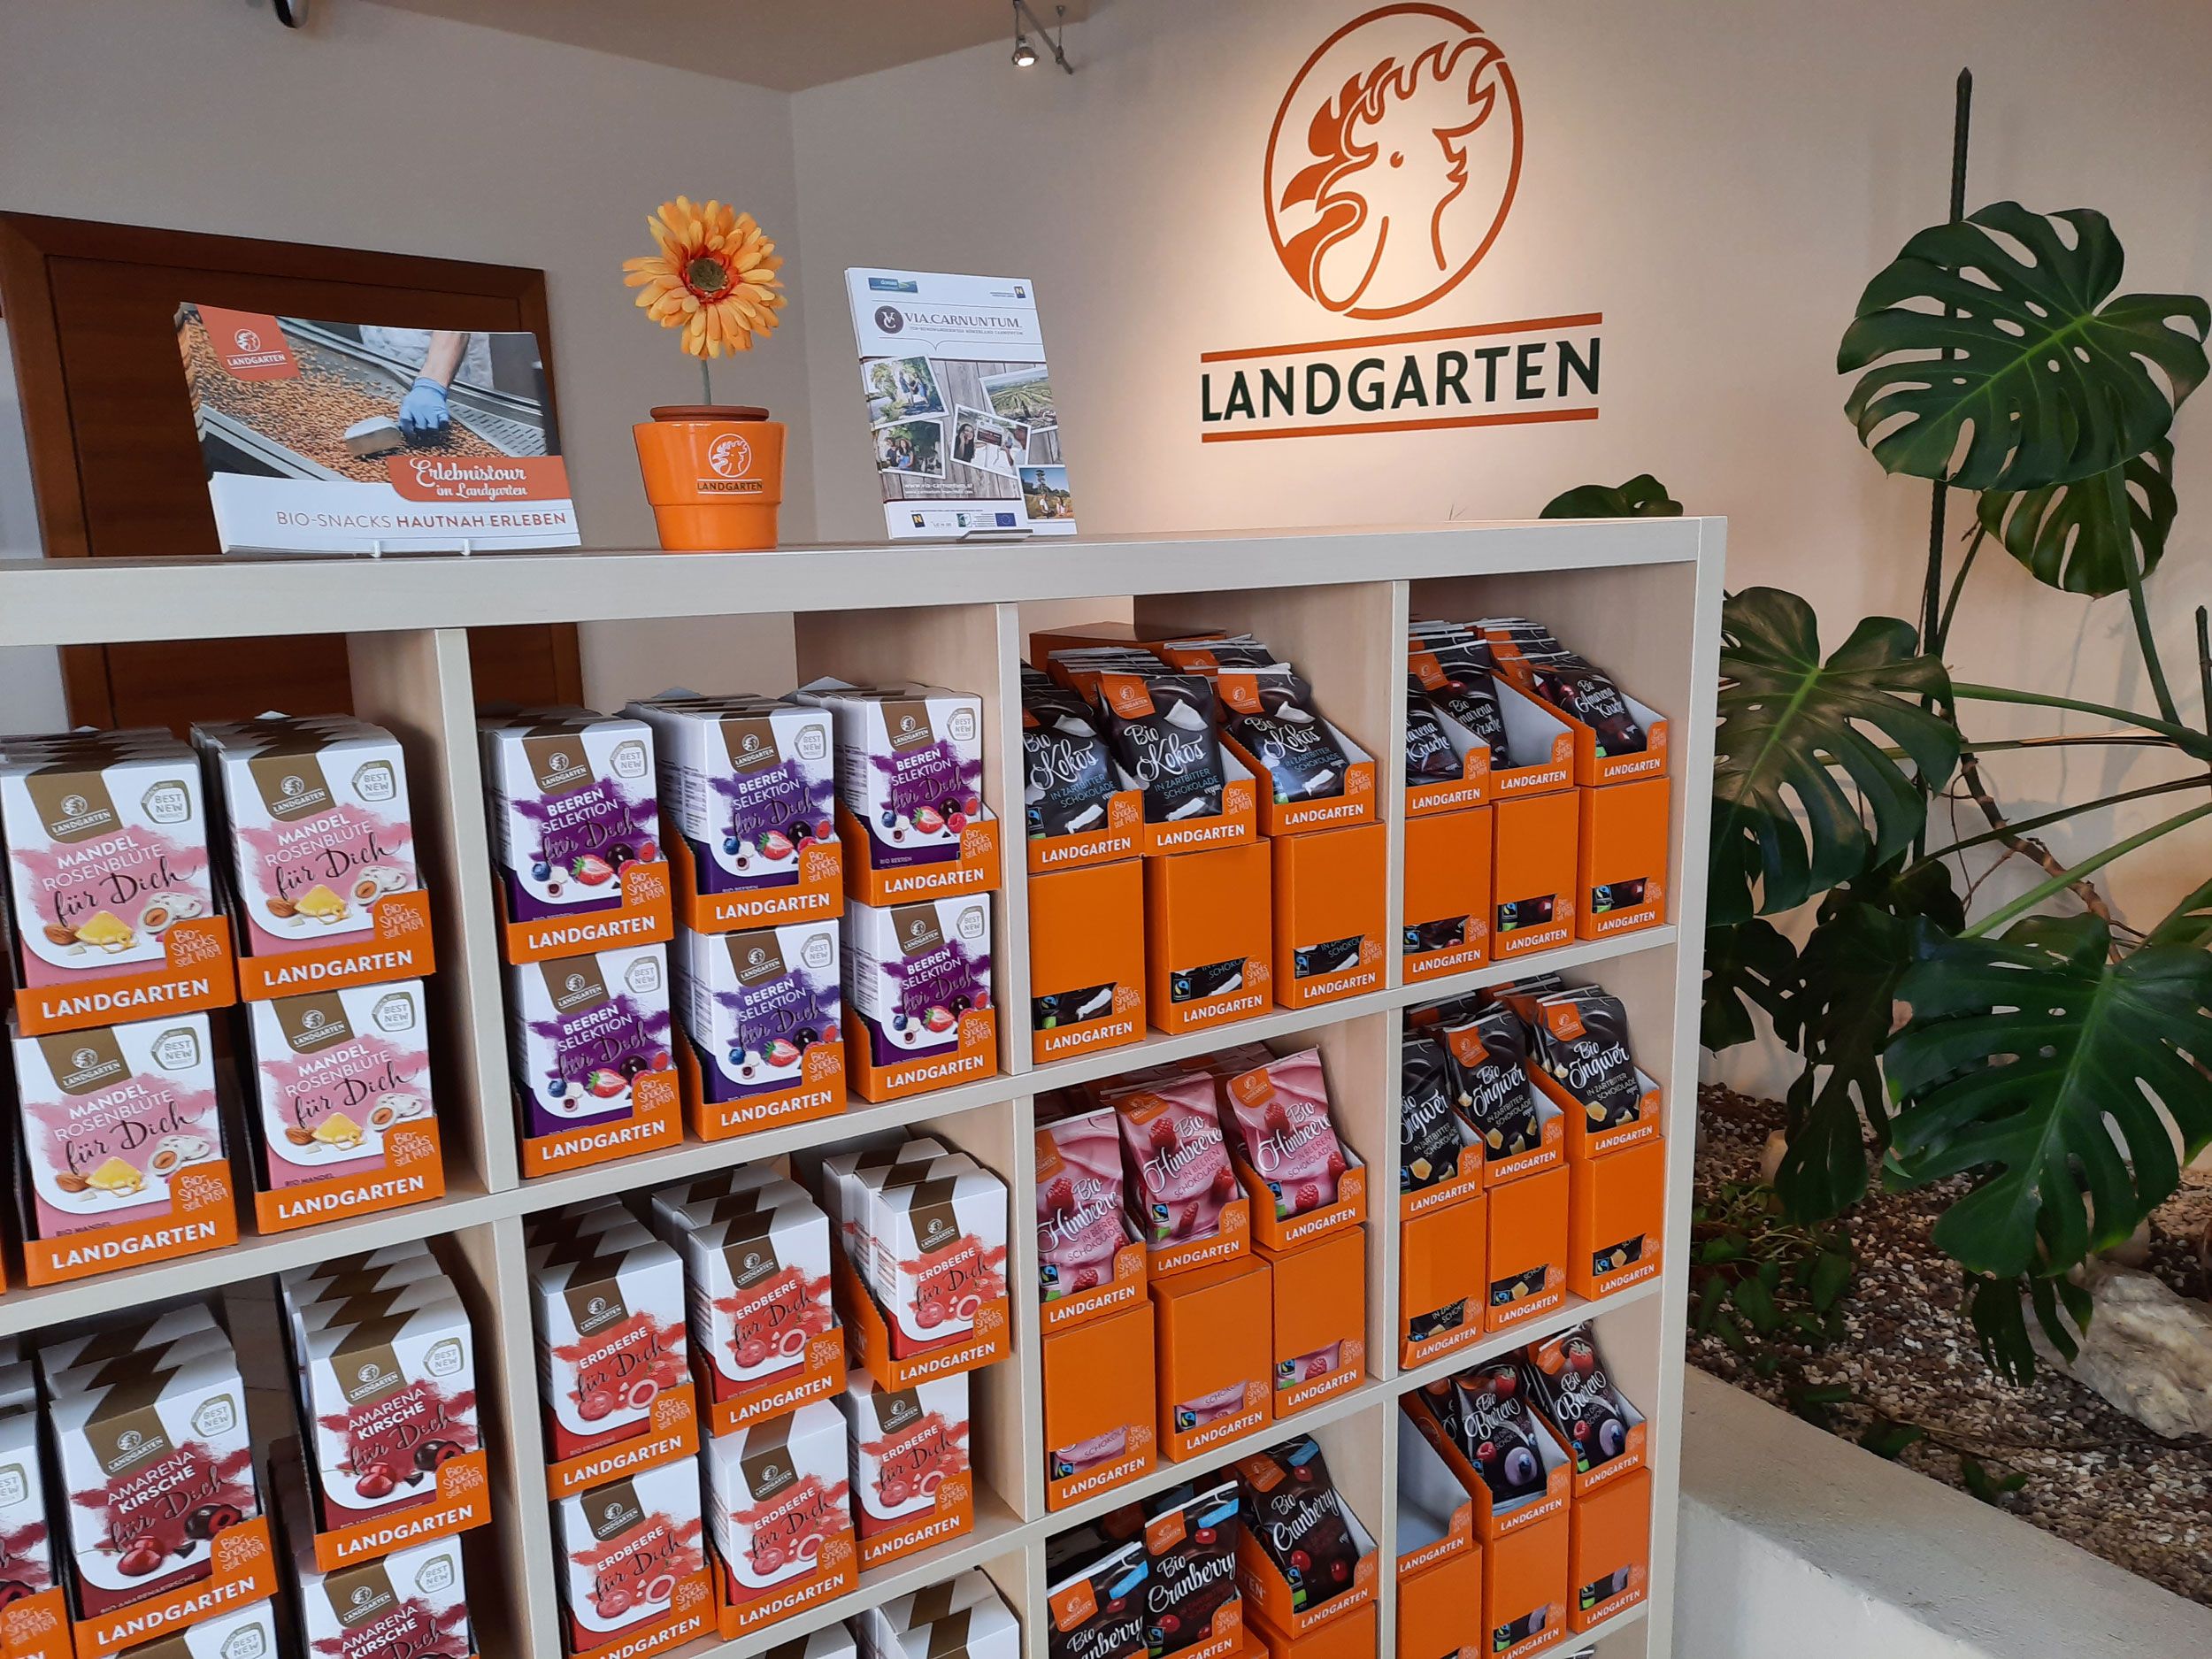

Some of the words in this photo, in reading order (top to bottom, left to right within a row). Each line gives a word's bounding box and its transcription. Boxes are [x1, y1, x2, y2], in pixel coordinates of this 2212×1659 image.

[227, 354, 285, 365] LANDGARTEN
[1202, 338, 1600, 421] LANDGARTEN
[410, 458, 526, 488] Erlebnistour
[456, 483, 527, 501] Landgarten
[277, 511, 391, 528] BIO-SNACKS
[397, 514, 485, 528] HAUTNAH
[490, 512, 566, 527] ERLEBEN
[1575, 687, 1615, 713] Amarena
[1578, 680, 1594, 692] Bio
[1244, 718, 1275, 732] Bio
[1596, 701, 1624, 718] Kirsche
[1024, 733, 1050, 752] Bio
[1124, 725, 1158, 745] Bio
[1263, 724, 1321, 759] Kokos
[1406, 733, 1450, 762] Kirsche
[620, 760, 641, 769] NEW
[892, 758, 951, 787] SELEKTION
[896, 749, 941, 772] BEEREN
[1031, 739, 1098, 790] Kokos
[1136, 733, 1206, 782] Kokos
[1604, 759, 1661, 777] LANDGARTEN
[365, 773, 388, 783] BEST
[541, 767, 587, 787] LANDGARTEN
[738, 769, 788, 795] BEEREN
[1062, 774, 1106, 796] ZARTBITTER
[1164, 768, 1210, 788] ZARTBITTER
[1164, 775, 1219, 799] SCHOKOLADE
[1501, 771, 1567, 789] LANDGARTEN
[155, 794, 181, 804] BEST
[156, 803, 182, 813] NEW
[273, 790, 325, 812] LANDGARTEN
[547, 788, 604, 817] BEEREN
[733, 779, 800, 810] SELEKTION
[1062, 781, 1116, 808] SCHOKOLADE
[1412, 788, 1480, 809] LANDGARTEN
[52, 811, 111, 833] LANDGARTEN
[278, 813, 350, 846] MANDEL
[541, 799, 618, 834] SELEKTION
[579, 807, 648, 849] Dich
[1286, 804, 1363, 825] LANDGARTEN
[265, 821, 373, 867] ROSENBLÜTE
[1042, 838, 1131, 863] LANDGARTEN
[1157, 825, 1245, 846] LANDGARTEN
[44, 843, 163, 892] ROSENBLÜTE
[58, 836, 139, 870] MANDEL
[276, 867, 314, 901] für
[317, 833, 402, 878] Dich
[54, 891, 98, 928] für
[100, 856, 196, 905] Dich
[885, 868, 984, 893] LANDGARTEN
[716, 893, 830, 920] LANDGARTEN
[528, 916, 655, 949] LANDGARTEN
[264, 950, 412, 987] LANDGARTEN
[902, 957, 961, 990] SELEKTION
[907, 949, 950, 975] BEEREN
[1413, 950, 1481, 973] LANDGARTEN
[42, 979, 210, 1019] LANDGARTEN
[744, 979, 795, 1006] BEEREN
[1304, 972, 1376, 998] LANDGARTEN
[564, 1005, 619, 1034] BEEREN
[740, 987, 807, 1022] SELEKTION
[1184, 995, 1263, 1023] LANDGARTEN
[558, 1014, 633, 1052] SELEKTION
[1045, 1021, 1133, 1051] LANDGARTEN
[298, 1044, 370, 1077] MANDEL
[1570, 1041, 1630, 1089] Ingwer
[1574, 1041, 1600, 1060] Bio
[285, 1051, 392, 1097] ROSENBLÜTE
[887, 1055, 984, 1088] LANDGARTEN
[1477, 1064, 1500, 1085] Bio
[69, 1084, 149, 1119] MANDEL
[295, 1096, 333, 1129] für
[335, 1061, 419, 1106] Dich
[1473, 1063, 1525, 1117] Ingwer
[1598, 1079, 1636, 1101] SCHOKOLADE
[54, 1090, 173, 1141] ROSENBLÜTE
[721, 1090, 832, 1126] LANDGARTEN
[1286, 1102, 1315, 1124] Bio
[66, 1140, 108, 1175] für
[110, 1102, 204, 1150] Dich
[542, 1120, 665, 1160] LANDGARTEN
[1174, 1116, 1203, 1138] Bio
[1595, 1125, 1653, 1150] LANDGARTEN
[1144, 1127, 1223, 1194] Himbeere
[1288, 1146, 1333, 1178] SCHOKOLADE
[1495, 1151, 1556, 1178] LANDGARTEN
[1071, 1179, 1102, 1200] Bio
[1175, 1160, 1220, 1198] SCHOKOLADE
[279, 1176, 424, 1219] LANDGARTEN
[1410, 1181, 1475, 1211] LANDGARTEN
[1286, 1208, 1356, 1240] LANDGARTEN
[52, 1221, 216, 1270] LANDGARTEN
[1068, 1225, 1120, 1261] SCHOKOLADE
[1158, 1240, 1240, 1271] LANDGARTEN
[919, 1248, 976, 1281] ERDBEERE
[736, 1279, 797, 1320] ERDBEERE
[1049, 1286, 1135, 1324] LANDGARTEN
[580, 1327, 648, 1369] ERDBEERE
[1417, 1327, 1476, 1359] LANDGARTEN
[577, 1371, 609, 1402] für
[609, 1334, 675, 1377] Dich
[900, 1342, 995, 1381] LANDGARTEN
[1561, 1372, 1580, 1392] Bio
[348, 1388, 426, 1431] AMARENA
[730, 1376, 833, 1424] LANDGARTEN
[1476, 1393, 1497, 1412] Bio
[357, 1402, 426, 1440] KIRSCHE
[388, 1403, 466, 1450] Dich
[1187, 1411, 1263, 1450] LANDGARTEN
[882, 1425, 938, 1463] ERDBEERE
[564, 1436, 682, 1486] LANDGARTEN
[1585, 1455, 1639, 1488] LANDGARTEN
[108, 1452, 196, 1506] AMARENA
[119, 1465, 196, 1514] KIRSCHE
[155, 1465, 242, 1519] Dich
[1063, 1457, 1145, 1500] LANDGARTEN
[755, 1487, 816, 1530] ERDBEERE
[1271, 1493, 1295, 1516] Bio
[1273, 1486, 1340, 1551] Cranberry
[1501, 1499, 1562, 1531] LANDGARTEN
[336, 1505, 473, 1557] LANDGARTEN
[864, 1516, 960, 1561] LANDGARTEN
[597, 1526, 664, 1571] ERDBEERE
[1400, 1538, 1464, 1573] LANDGARTEN
[595, 1572, 628, 1602] für
[626, 1532, 687, 1576] Dich
[1148, 1552, 1236, 1613] Cranberry
[1157, 1555, 1187, 1579] Bio
[97, 1577, 255, 1646] LANDGARTEN
[740, 1574, 844, 1625] LANDGARTEN
[1301, 1588, 1368, 1629] LANDGARTEN
[1586, 1589, 1640, 1624] LANDGARTEN
[342, 1606, 418, 1653] AMARENA
[350, 1618, 418, 1659] KIRSCHE
[1066, 1628, 1094, 1652] Bio
